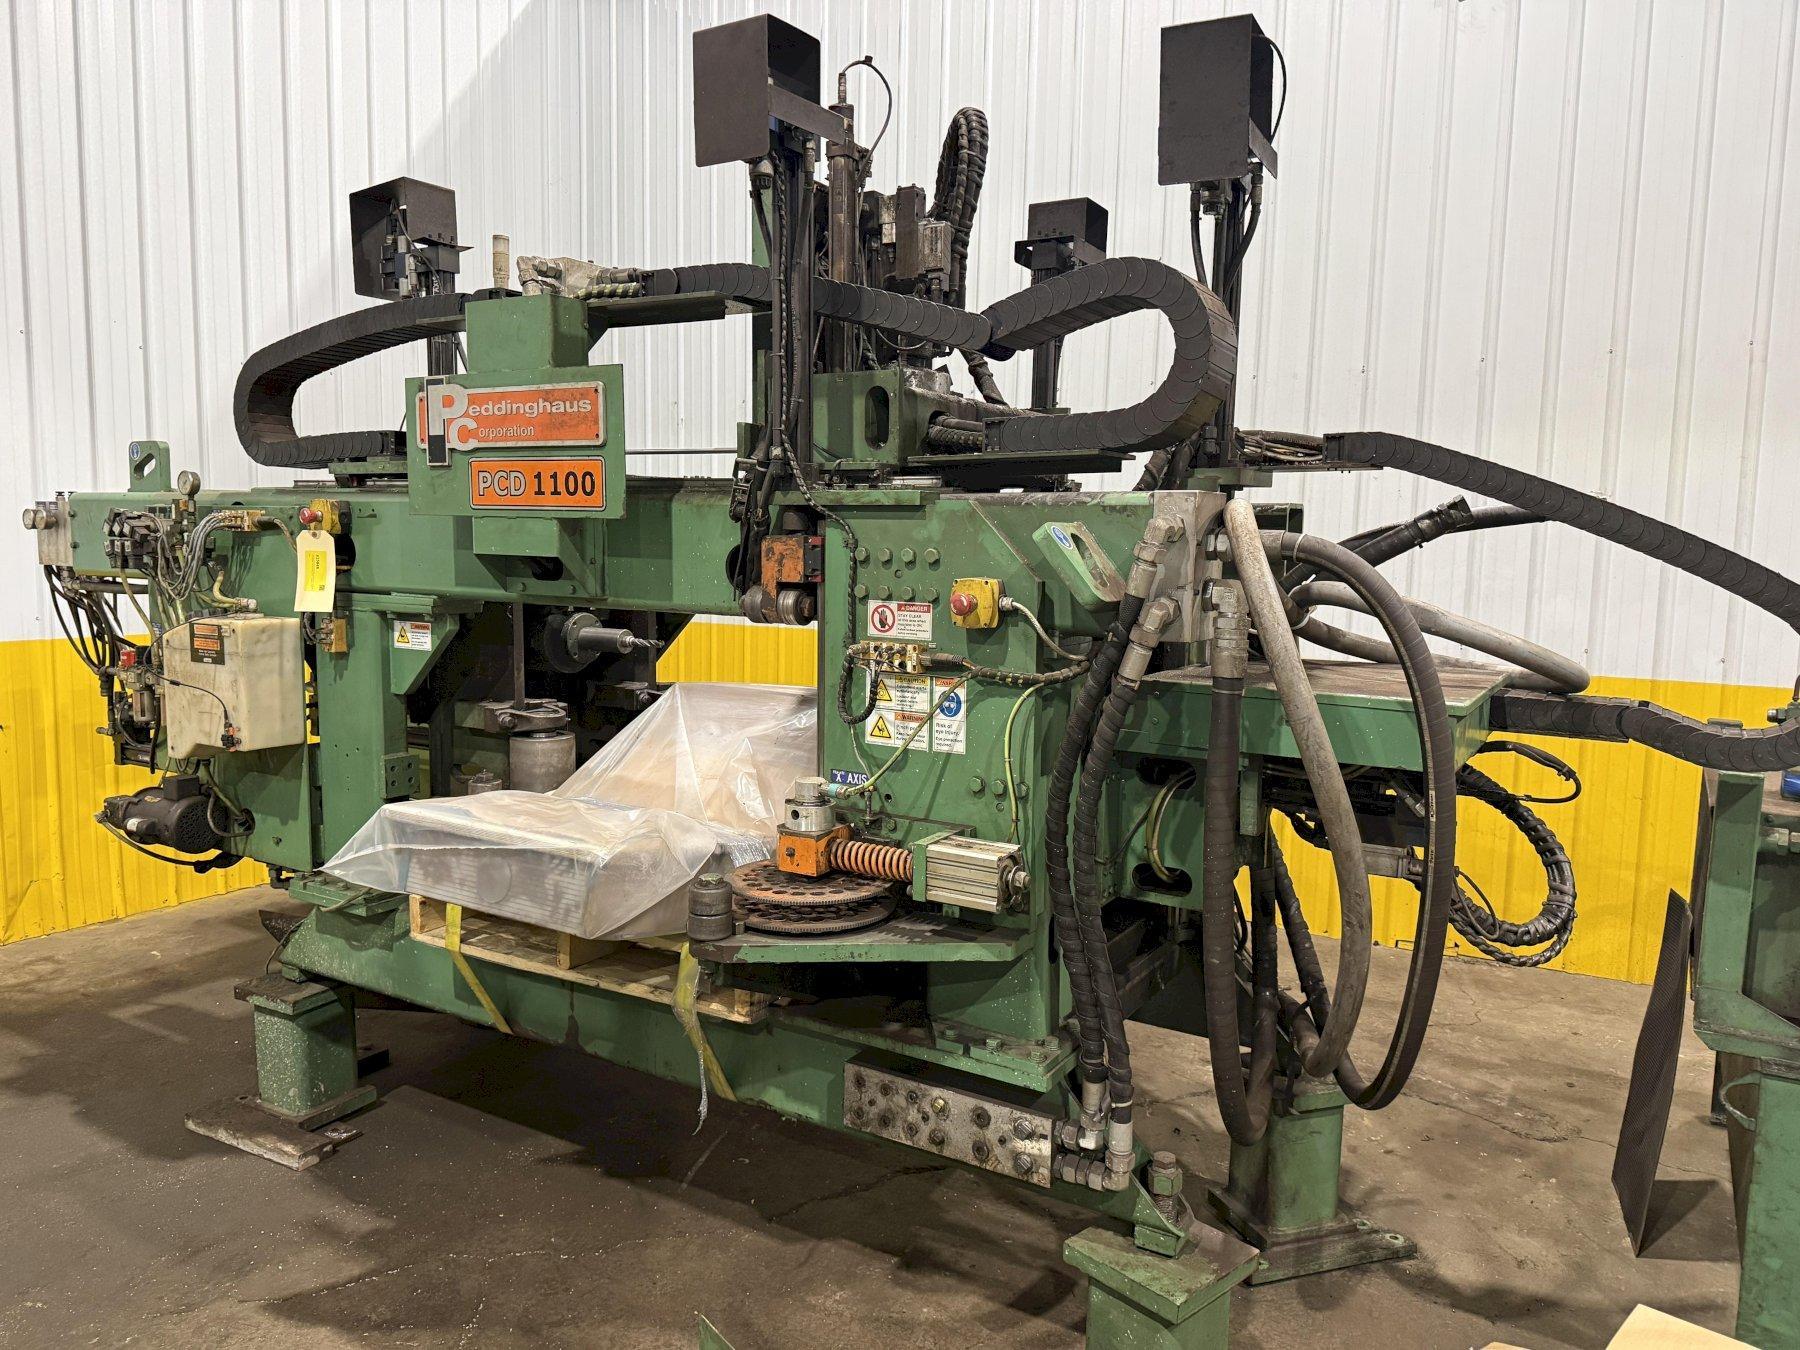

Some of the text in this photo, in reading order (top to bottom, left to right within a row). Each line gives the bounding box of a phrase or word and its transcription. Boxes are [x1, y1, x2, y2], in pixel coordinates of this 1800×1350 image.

[428, 384, 592, 436] Peddinghaus
[449, 418, 535, 451] Corporation
[478, 470, 596, 497] PCD 1100
[847, 773, 867, 785] AXIS
